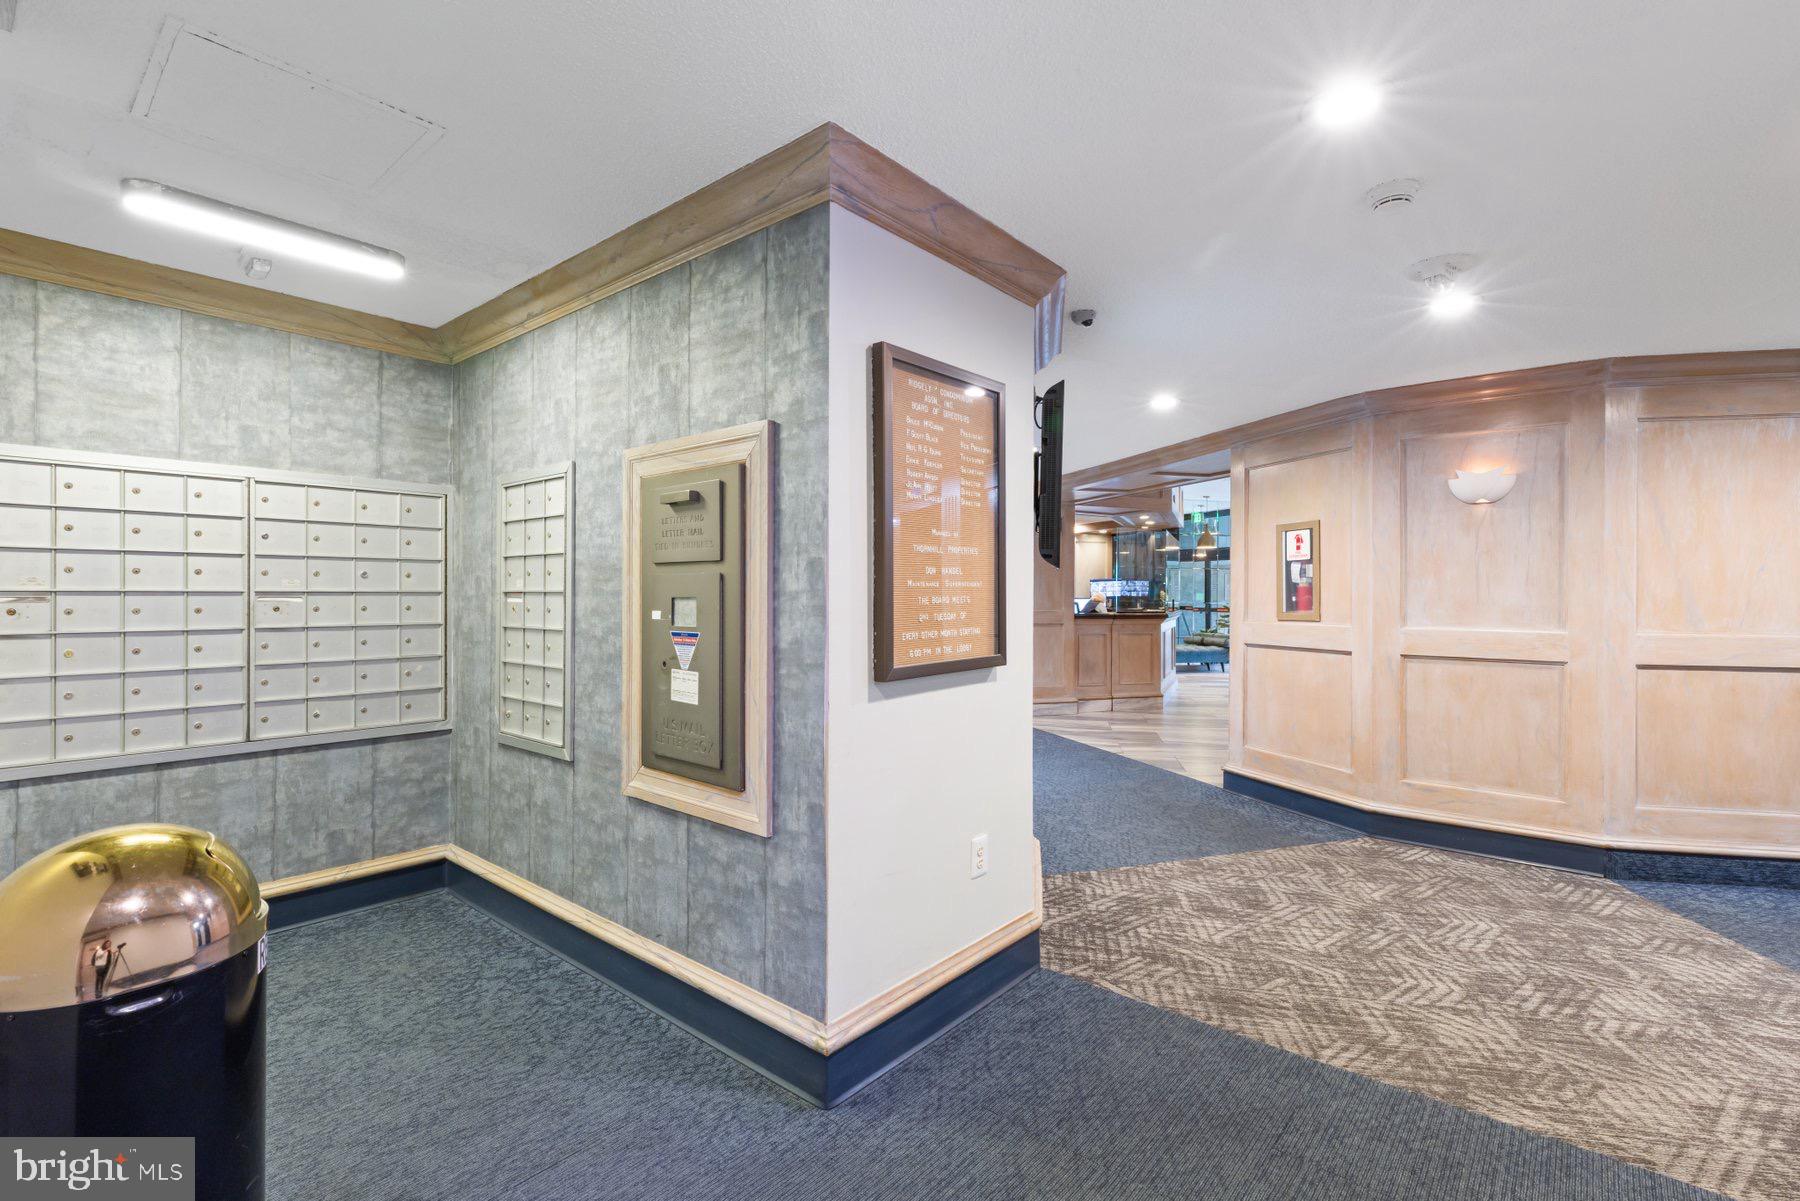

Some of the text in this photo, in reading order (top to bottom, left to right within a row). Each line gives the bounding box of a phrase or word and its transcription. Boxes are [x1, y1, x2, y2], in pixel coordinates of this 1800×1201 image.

[911, 401, 929, 413] BOARD
[932, 407, 939, 416] OF
[943, 410, 971, 425] DIRECTORS
[661, 528, 687, 538] LETTER
[948, 545, 979, 556] PROPERTIES
[917, 595, 971, 605] THE BOARD MEETS
[934, 613, 957, 622] TUESDAY
[960, 612, 968, 620] OF
[902, 632, 919, 641] EVERY
[920, 631, 938, 640] OTHER
[940, 629, 958, 638] MONTH
[923, 648, 931, 656] PM
[935, 647, 942, 655] IN
[944, 645, 954, 654] THE
